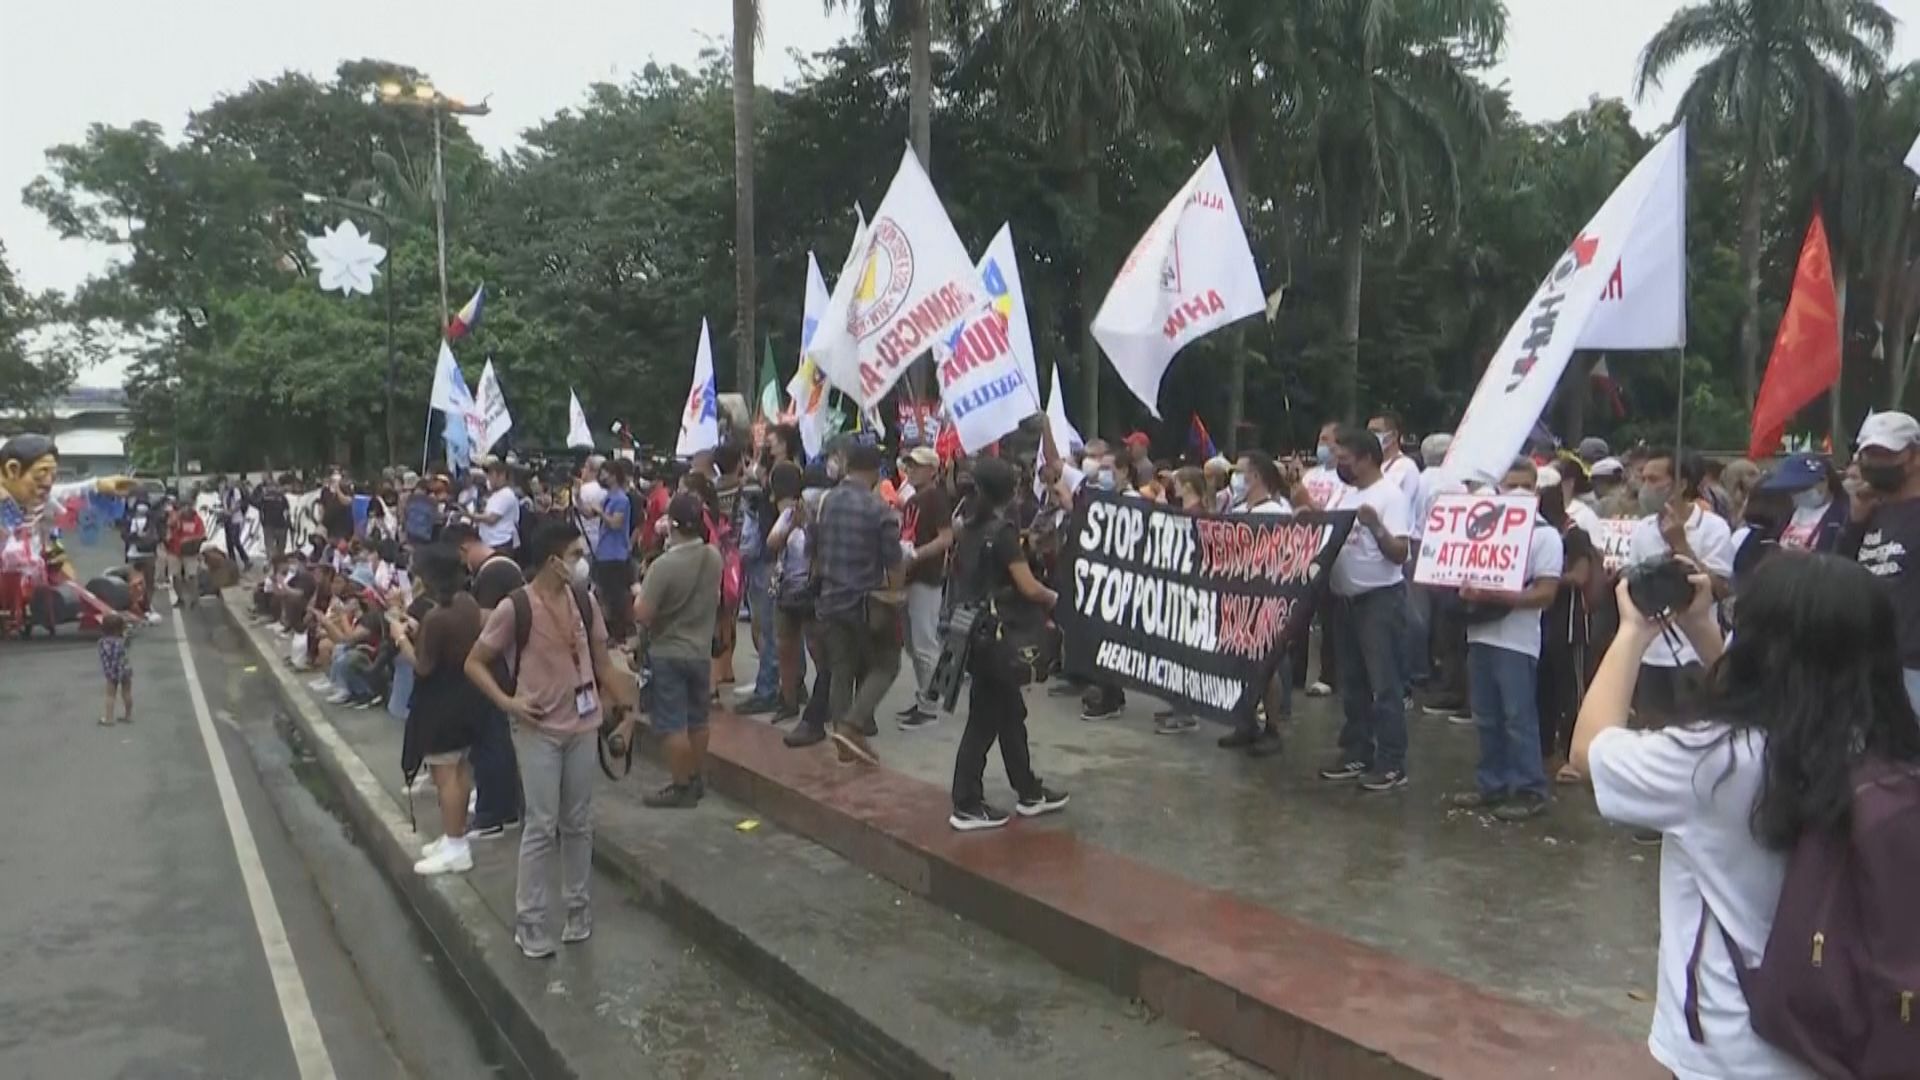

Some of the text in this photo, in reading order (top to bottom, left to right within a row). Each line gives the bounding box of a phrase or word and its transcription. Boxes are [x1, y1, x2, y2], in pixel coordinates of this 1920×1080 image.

[1079, 502, 1334, 586] STOP STATE TERRORISM!
[1428, 500, 1528, 542] STOP
[1437, 541, 1519, 570] ATTACKS!
[1074, 558, 1135, 626] STOP
[1131, 571, 1218, 653] POLITICAL
[1096, 641, 1147, 682] HEALTH
[1147, 656, 1183, 694] ACTION
[1183, 667, 1202, 703] FOR
